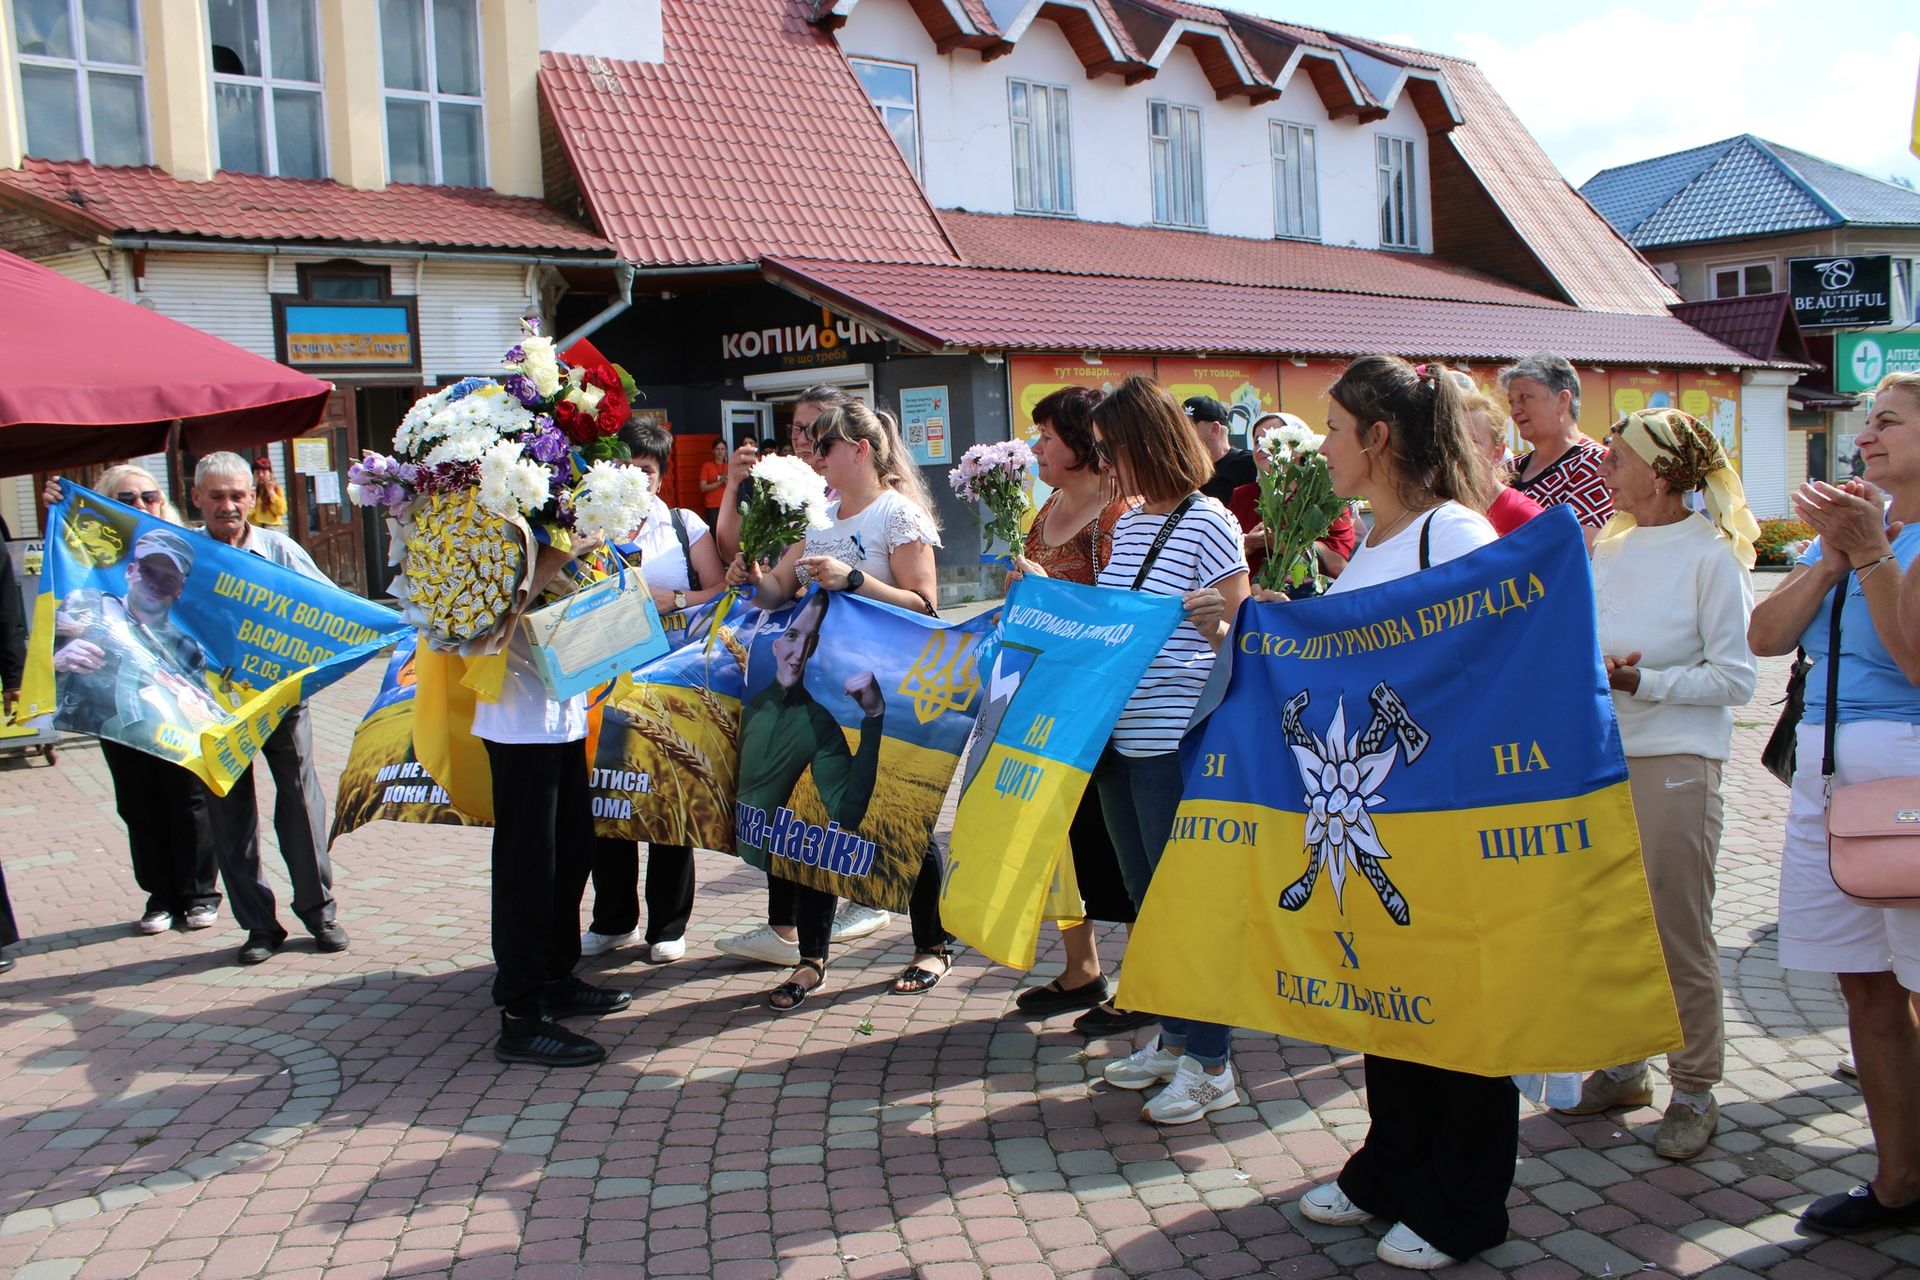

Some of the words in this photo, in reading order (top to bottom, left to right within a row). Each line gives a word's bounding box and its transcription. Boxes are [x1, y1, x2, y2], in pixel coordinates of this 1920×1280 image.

[1795, 293, 1887, 310] BEAUTIFUL
[374, 343, 406, 353] POST
[815, 349, 848, 363] треба
[1054, 367, 1071, 378] тут
[1193, 369, 1208, 379] тут
[1154, 513, 1181, 550] GUESS
[213, 571, 295, 619] ШАТРУК
[1416, 571, 1546, 638] БРИГАДА
[241, 653, 295, 681] 12.03.1
[1022, 713, 1055, 749] НА
[1201, 753, 1227, 777] ЗІ
[1490, 740, 1551, 775] НА
[376, 766, 399, 783] МИ
[399, 761, 421, 779] НЕ
[994, 757, 1044, 801] ЩИТІ
[382, 784, 429, 804] ПОКИ
[1477, 817, 1593, 864] ЩИТІ
[1275, 969, 1435, 1025] ЕДЕЛЬВЕЙС
